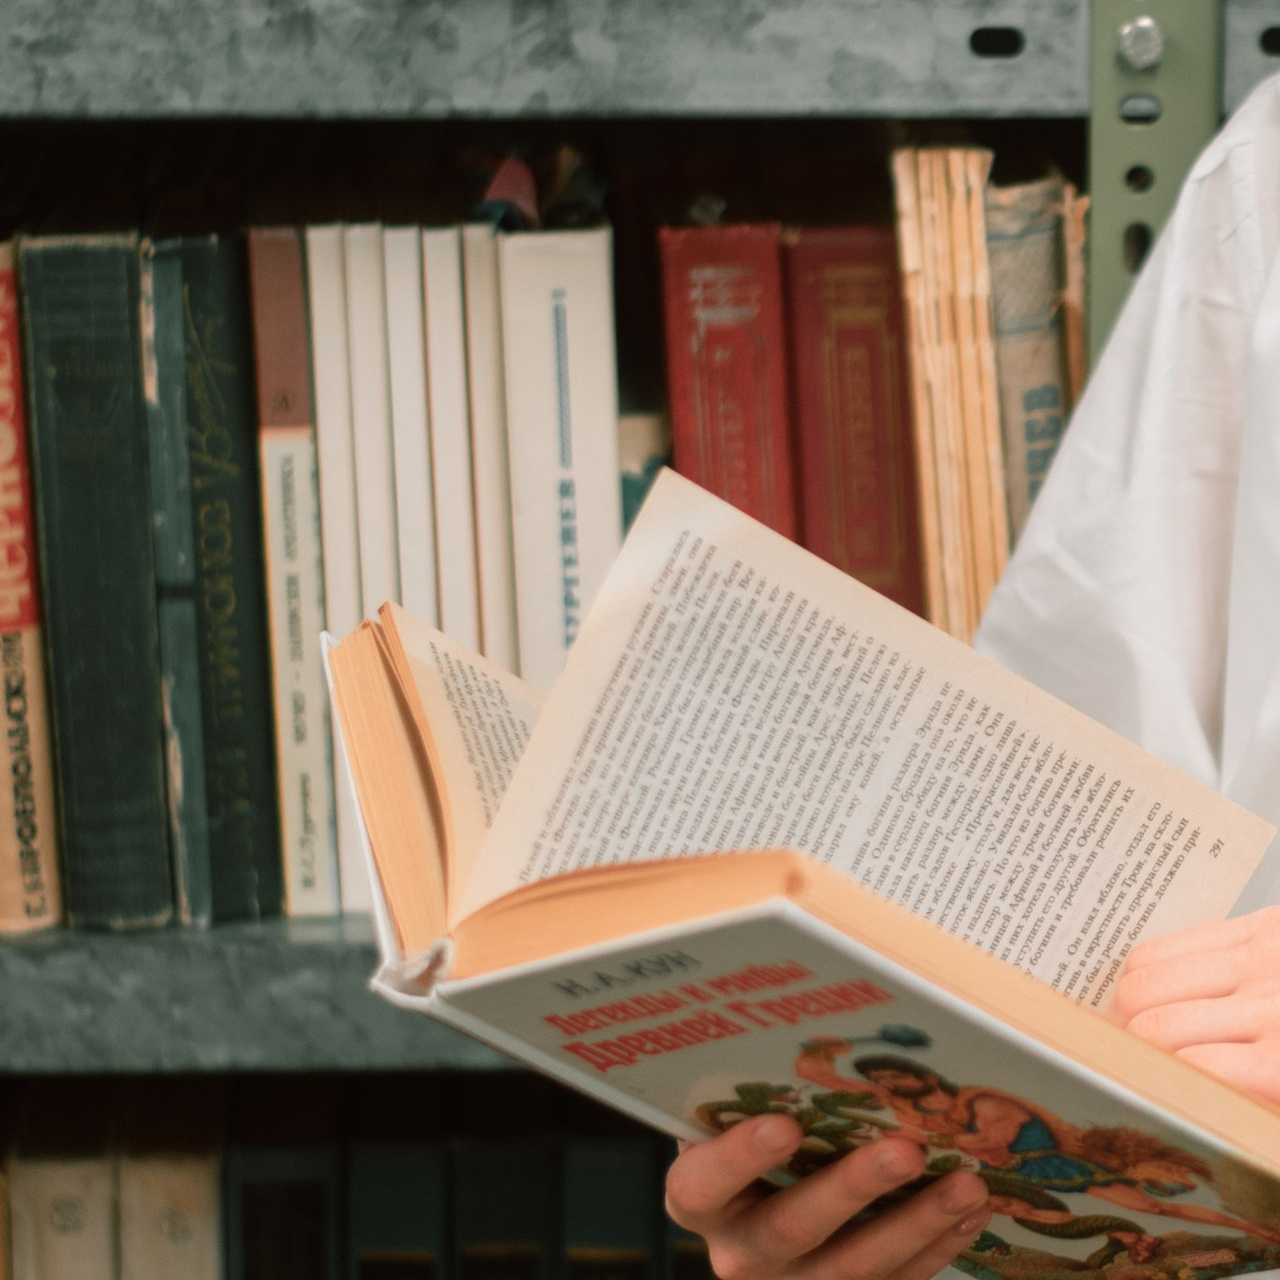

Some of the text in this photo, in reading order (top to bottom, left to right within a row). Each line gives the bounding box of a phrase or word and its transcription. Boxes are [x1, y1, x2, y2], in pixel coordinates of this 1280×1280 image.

[848, 838, 870, 874] лишь
[864, 792, 894, 838] богиня
[890, 740, 923, 793] раздора
[915, 697, 945, 740] Эрида
[891, 809, 920, 854] сердце
[911, 770, 939, 811] обиду
[941, 735, 959, 756] то,
[952, 711, 969, 735] что
[898, 703, 991, 873] наконец богиня Эрида, как
[916, 709, 1004, 870] раздор между ними. Она
[928, 725, 1032, 904] яблоке «Прекраснейшей».
[962, 740, 1056, 902] яблоко. Увидали боги ябло-
[972, 819, 997, 856] столу
[999, 781, 1017, 805] для
[1011, 753, 1031, 781] всех
[1027, 733, 1043, 753] не-
[979, 755, 1082, 936] спор между тремя богинями:
[1006, 862, 1041, 913] Афиной
[1039, 802, 1072, 852] богиней
[1066, 762, 1095, 802] любви
[1007, 921, 1024, 945] них
[1020, 880, 1047, 921] хотела
[1042, 824, 1080, 881] получить
[1073, 803, 1089, 825] это
[1082, 769, 1108, 804] ябло-
[1205, 837, 1225, 857] 291
[1026, 922, 1057, 967] богини
[1056, 848, 1100, 912] требовали
[1094, 803, 1127, 850] решить
[1079, 906, 1100, 935] взял
[1094, 857, 1130, 907] яблоко,
[1123, 822, 1150, 859] отдал
[1145, 800, 1161, 822] его
[1083, 816, 1189, 985] был решить прекрасный сын
[1087, 957, 1124, 1008] которой
[1125, 898, 1158, 942] богинь
[1153, 853, 1186, 900] должно
[1181, 824, 1205, 854] при-
[543, 959, 815, 1036] Легенды и мифы
[560, 978, 898, 1073] Древней Греции
